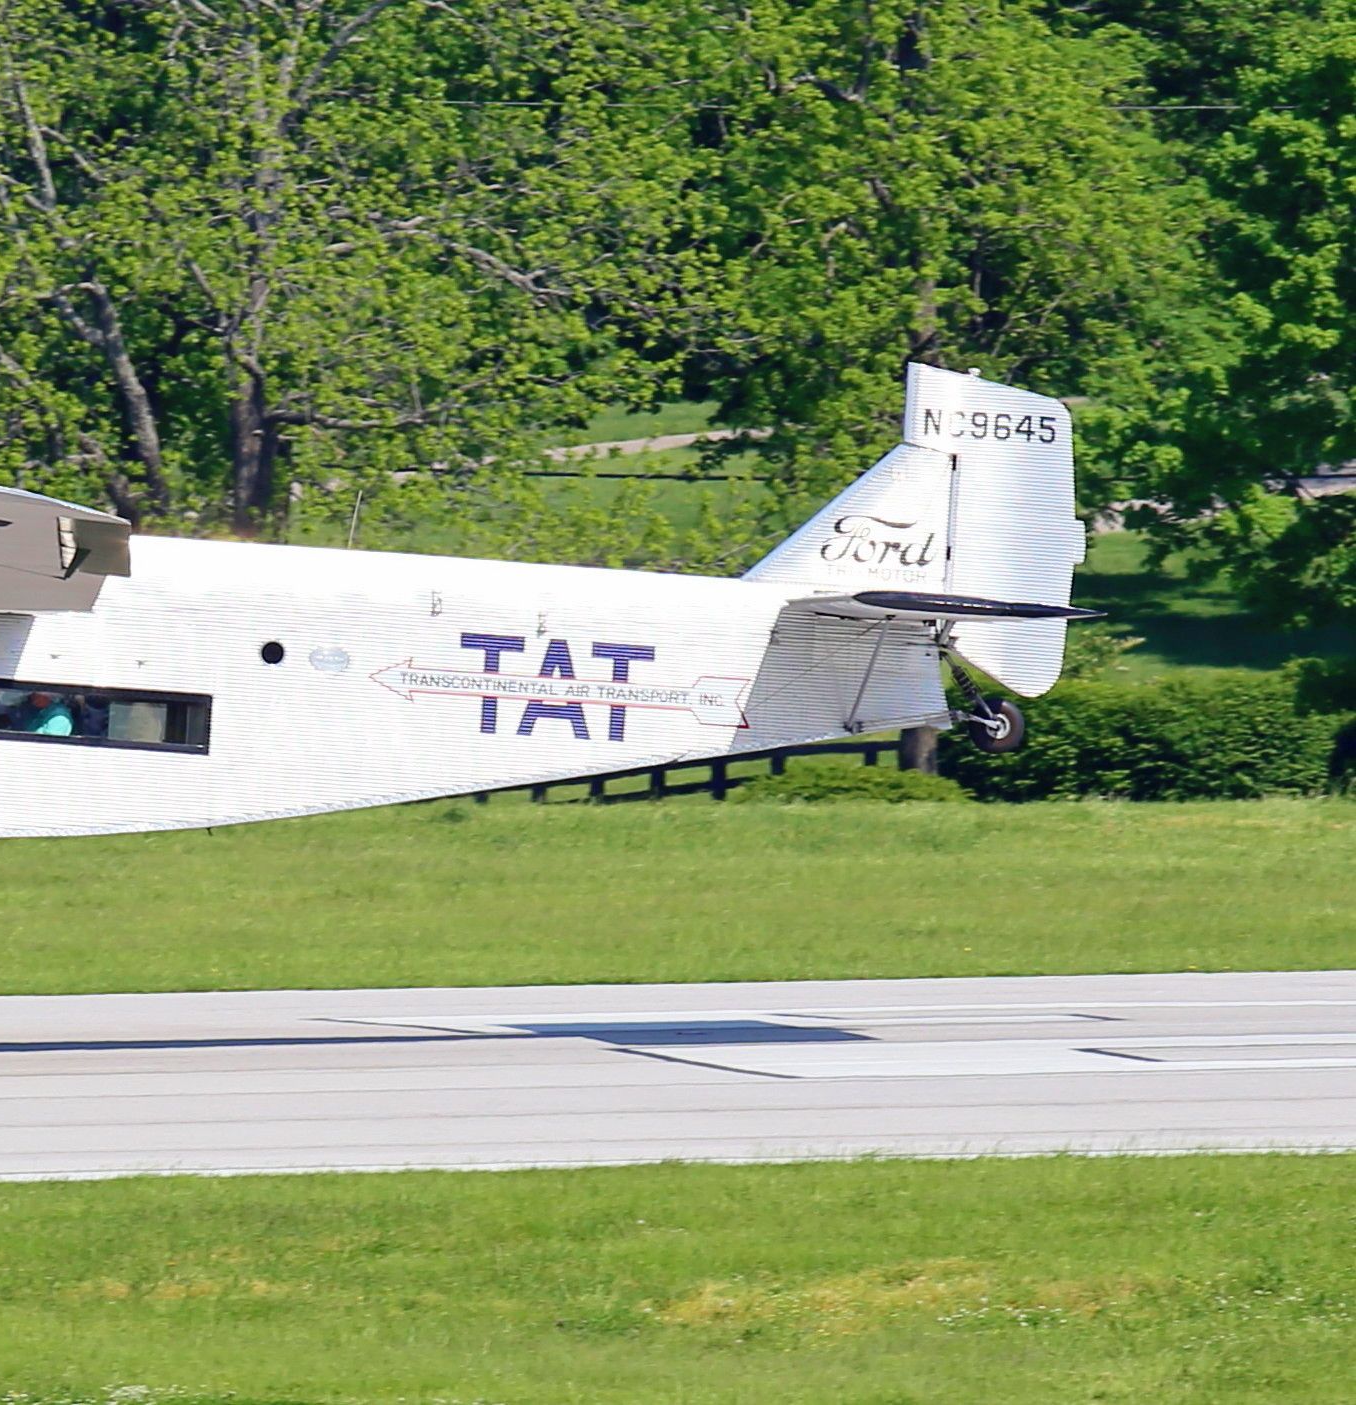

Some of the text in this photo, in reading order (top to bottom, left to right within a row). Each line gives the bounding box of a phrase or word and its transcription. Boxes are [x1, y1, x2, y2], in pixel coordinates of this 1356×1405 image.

[924, 408, 1056, 443] NC9645
[820, 515, 936, 566] Ford
[400, 672, 558, 695] TRANSCONTINENTAL
[564, 685, 589, 697] AIR
[461, 632, 655, 742] TAT
